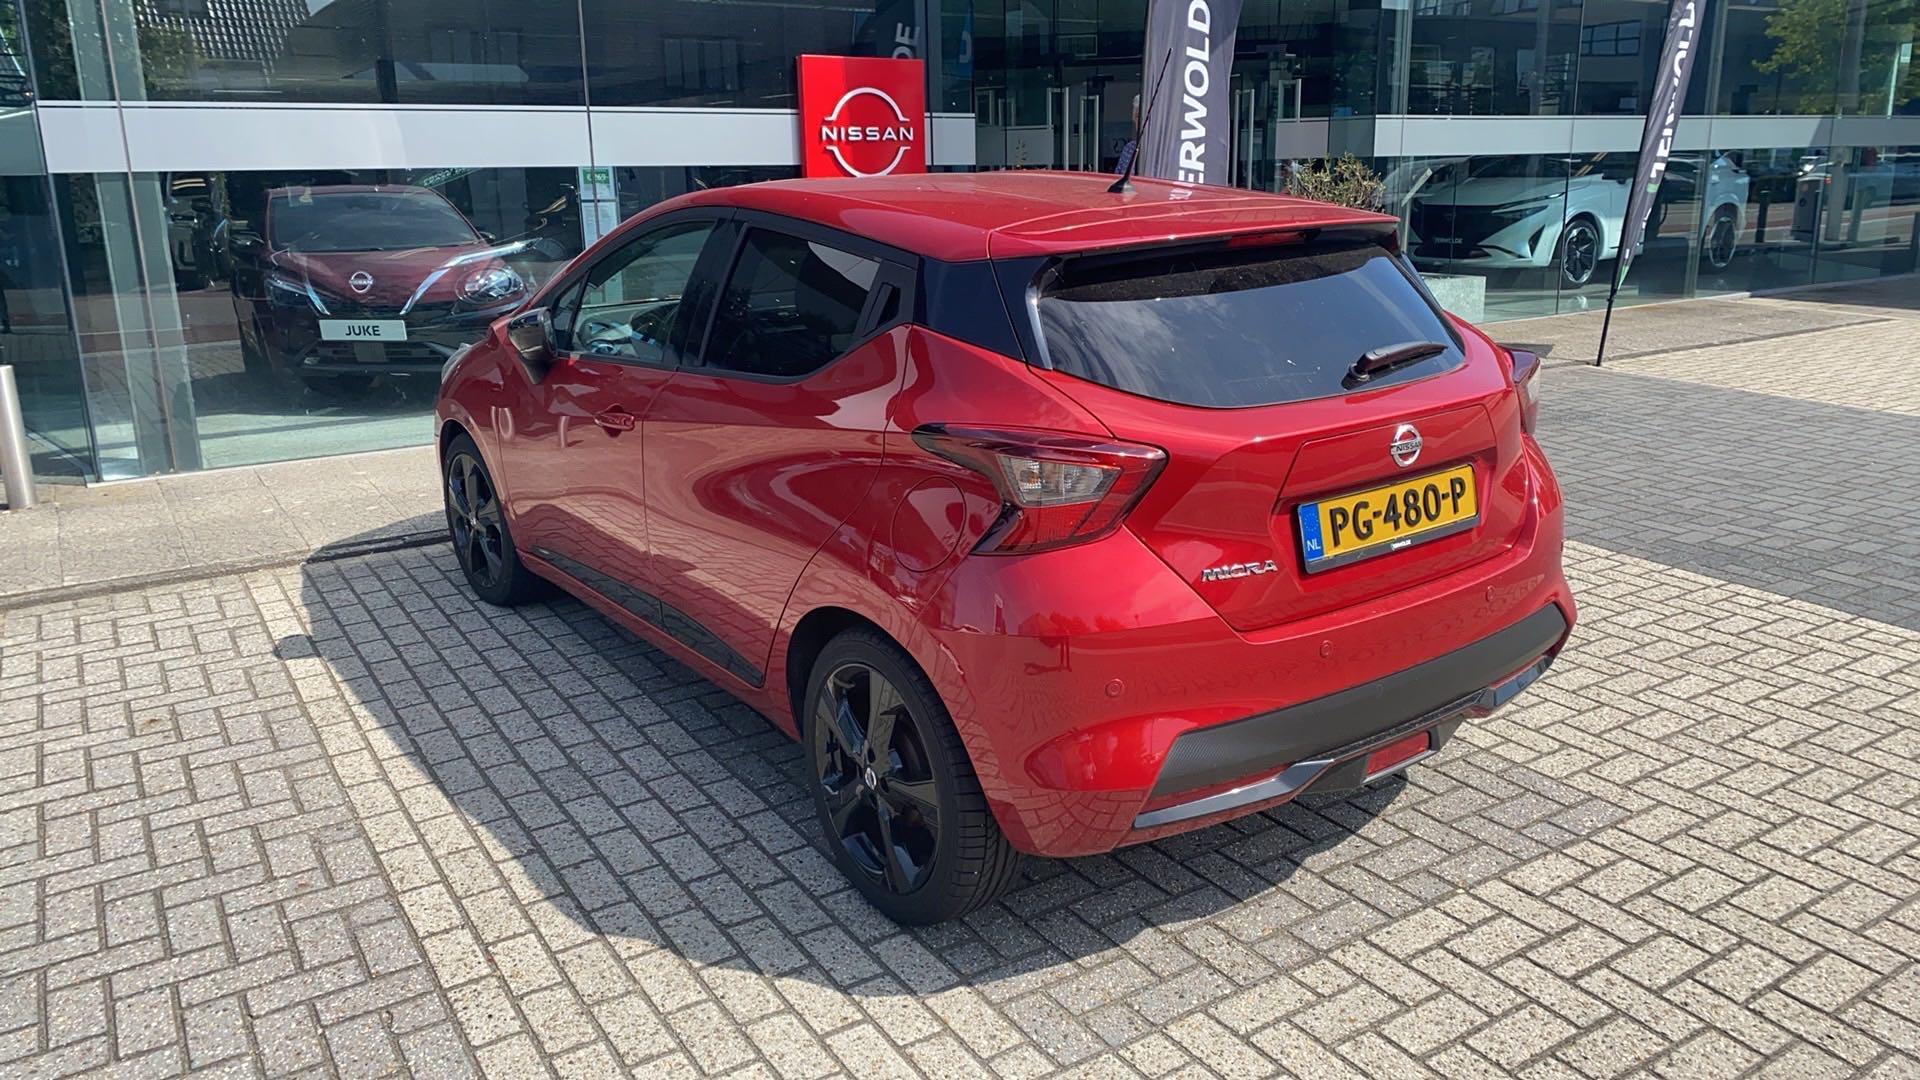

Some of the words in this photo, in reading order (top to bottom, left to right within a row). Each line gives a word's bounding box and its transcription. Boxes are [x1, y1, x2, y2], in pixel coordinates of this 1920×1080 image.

[821, 126, 914, 141] NISSAN
[345, 325, 381, 337] JUKE
[1329, 476, 1467, 548] PG-480-P
[1306, 538, 1321, 552] NL
[1201, 559, 1279, 583] MICRA
